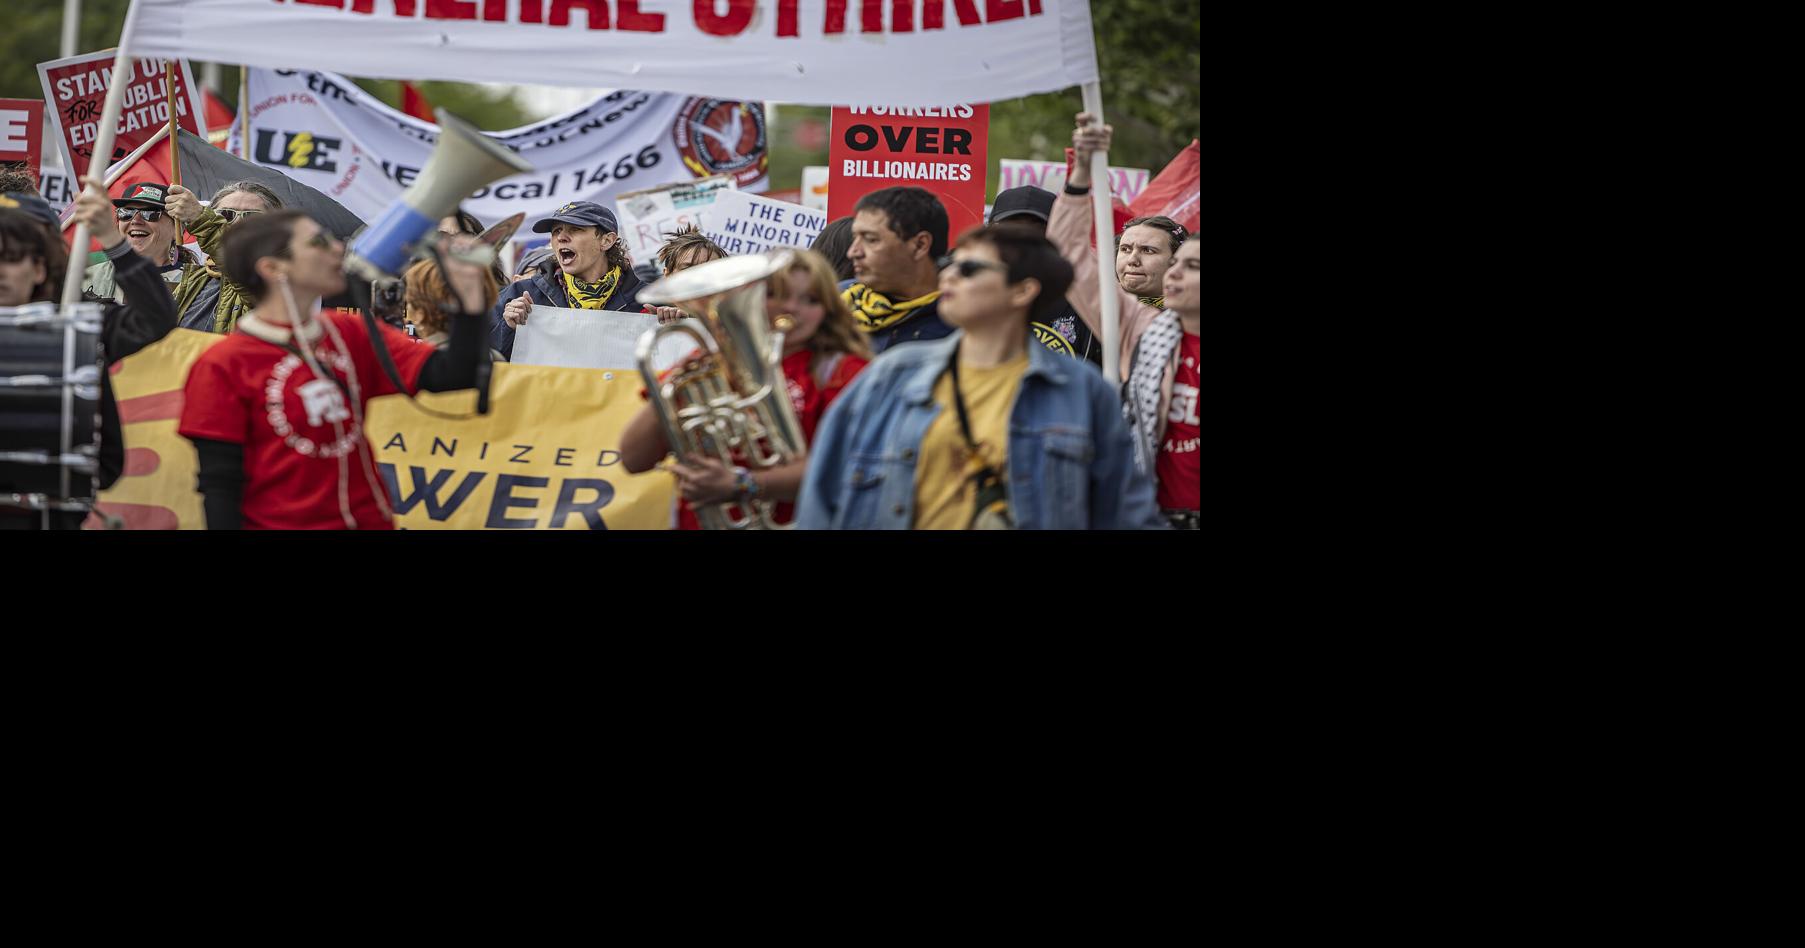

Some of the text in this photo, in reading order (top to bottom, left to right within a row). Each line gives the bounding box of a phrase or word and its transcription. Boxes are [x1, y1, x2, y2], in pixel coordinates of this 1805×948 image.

[122, 74, 182, 109] UBLIC
[64, 101, 101, 123] FOR
[69, 96, 188, 147] EDCATION
[844, 124, 972, 155] OVER
[471, 174, 561, 200] ocal
[573, 144, 662, 191] 1466
[843, 159, 972, 181] BILLIONAIRES
[1000, 163, 1147, 204] UNN
[749, 201, 827, 232] THE ONL
[705, 232, 777, 254] HURTI
[725, 217, 818, 249] MINORIT
[383, 432, 622, 467] ANIZED
